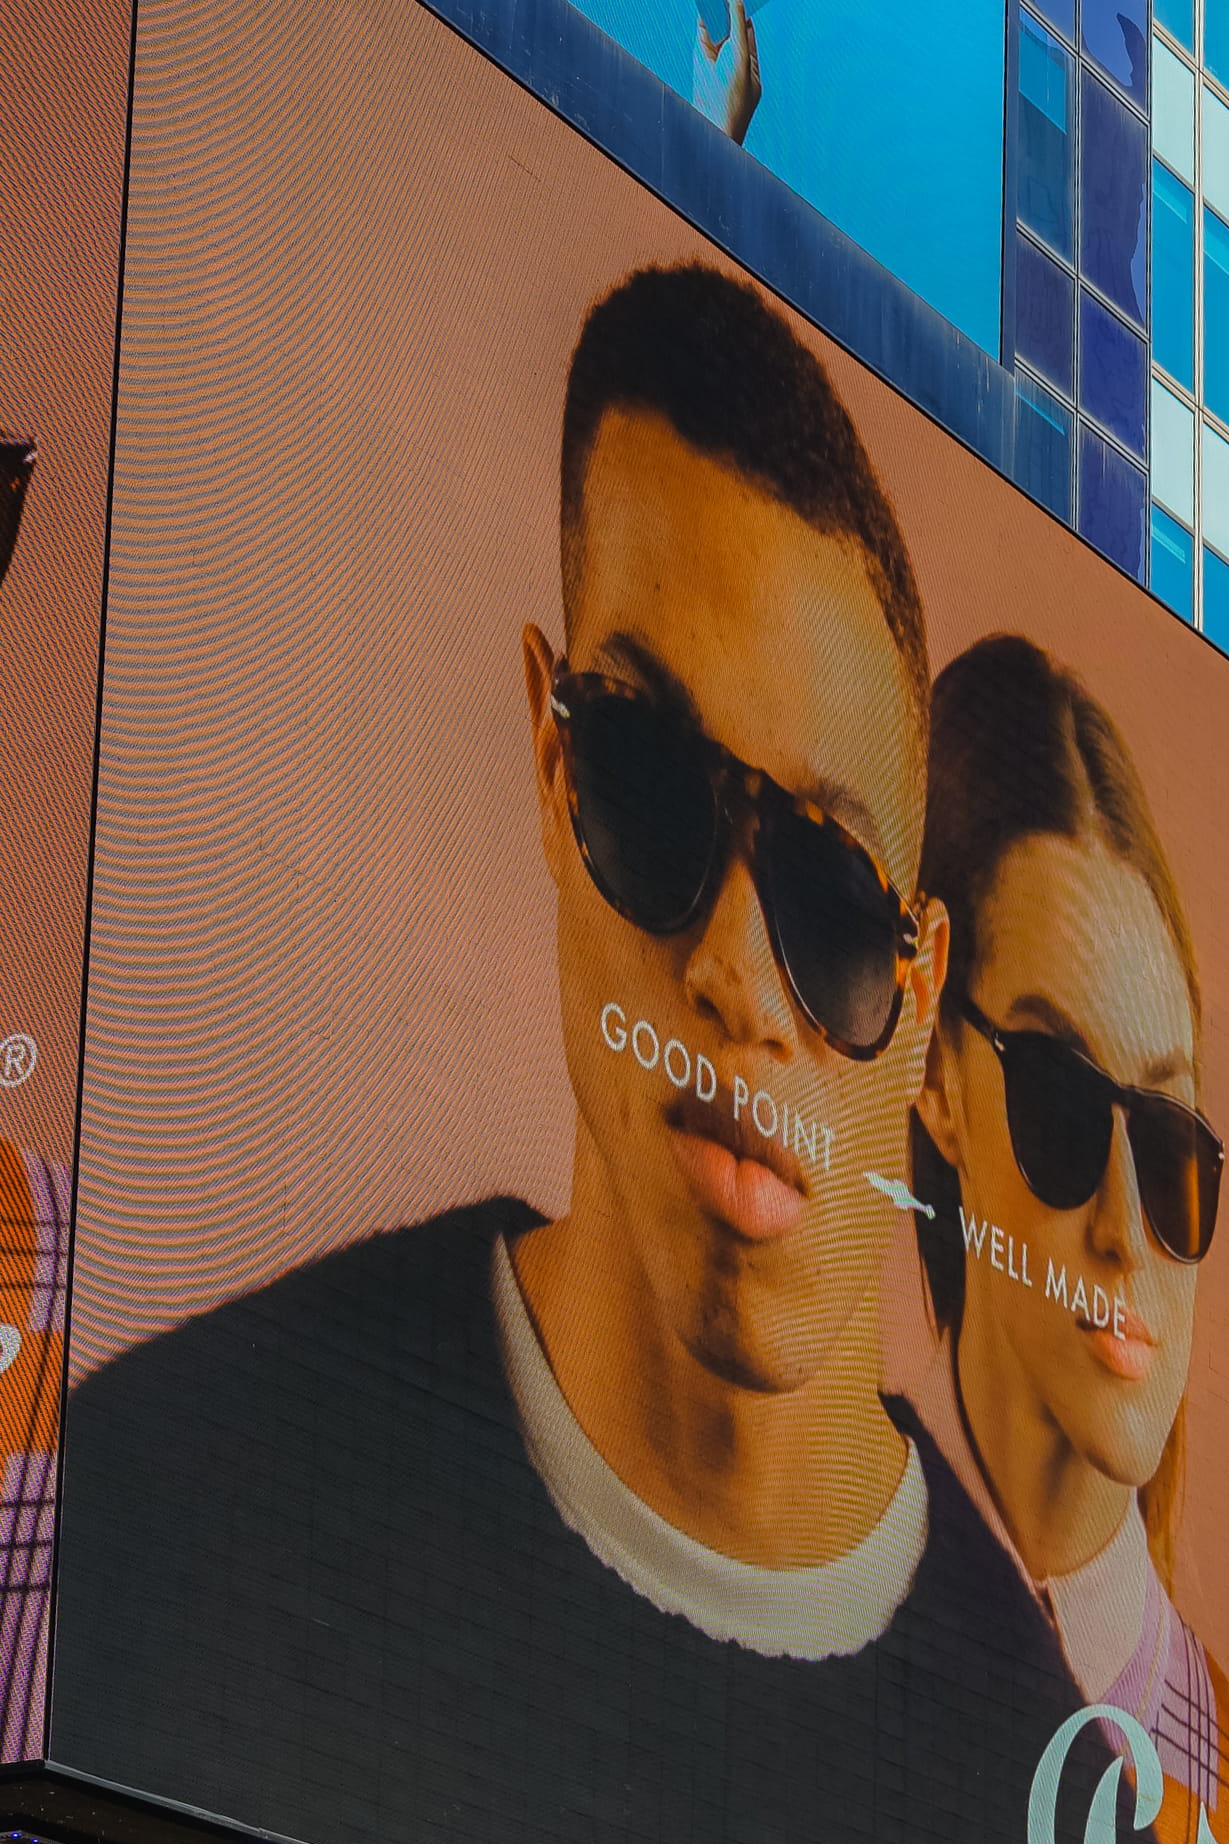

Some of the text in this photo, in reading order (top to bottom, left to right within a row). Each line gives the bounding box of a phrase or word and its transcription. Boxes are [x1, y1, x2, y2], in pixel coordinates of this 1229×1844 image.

[599, 1001, 837, 1171] GOOD POINT
[958, 1205, 1128, 1341] WELL MADE
